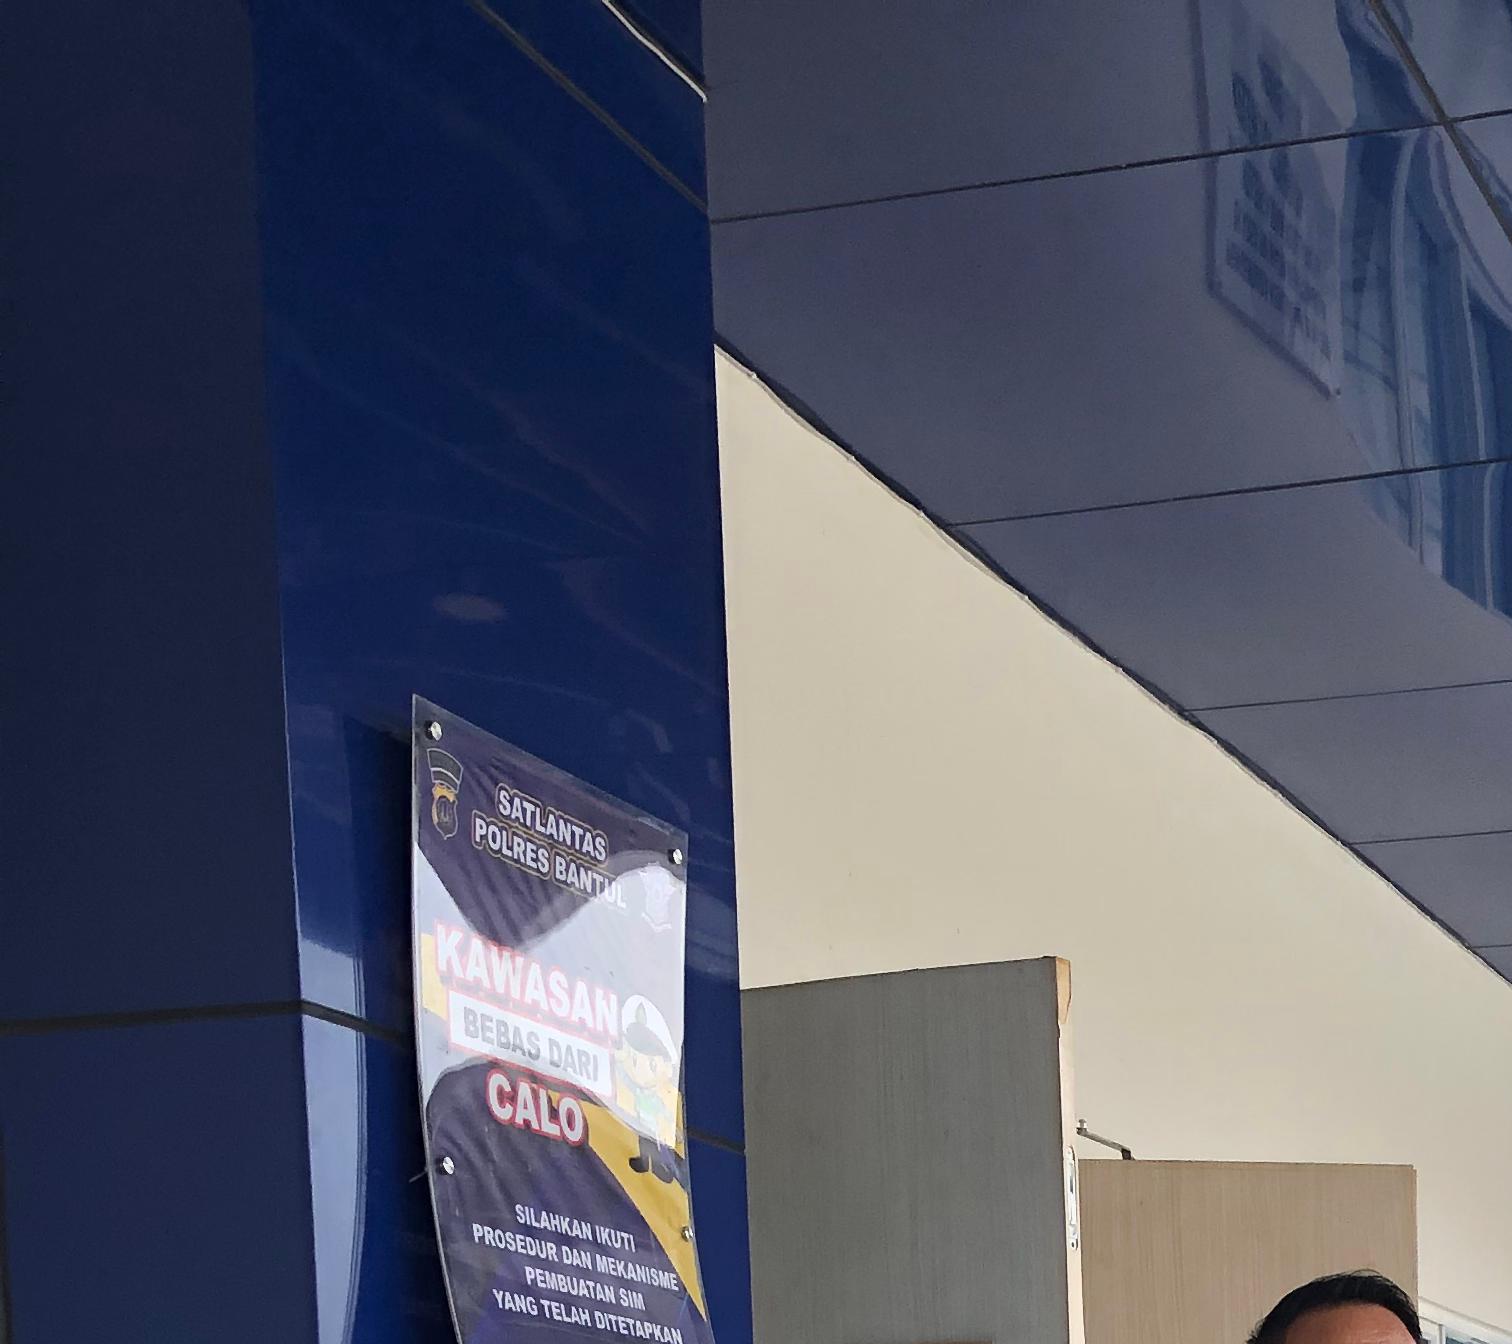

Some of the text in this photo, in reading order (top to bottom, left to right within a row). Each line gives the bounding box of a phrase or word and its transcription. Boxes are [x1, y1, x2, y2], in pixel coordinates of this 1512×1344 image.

[499, 789, 606, 861] SATLANTAS
[475, 817, 627, 909] POLRES BANTUL
[436, 924, 618, 1036] KAWASAN
[463, 1006, 599, 1082] BEBAS DARI
[488, 1072, 584, 1142] CALO
[472, 1223, 680, 1292] PROSEDUR DAN MEKANISME
[515, 1203, 636, 1253] SILAHKAN IKUTI
[492, 1288, 538, 1316] YANG
[539, 1298, 592, 1327] TELAH
[524, 1266, 646, 1311] PEMBUATAN SIM
